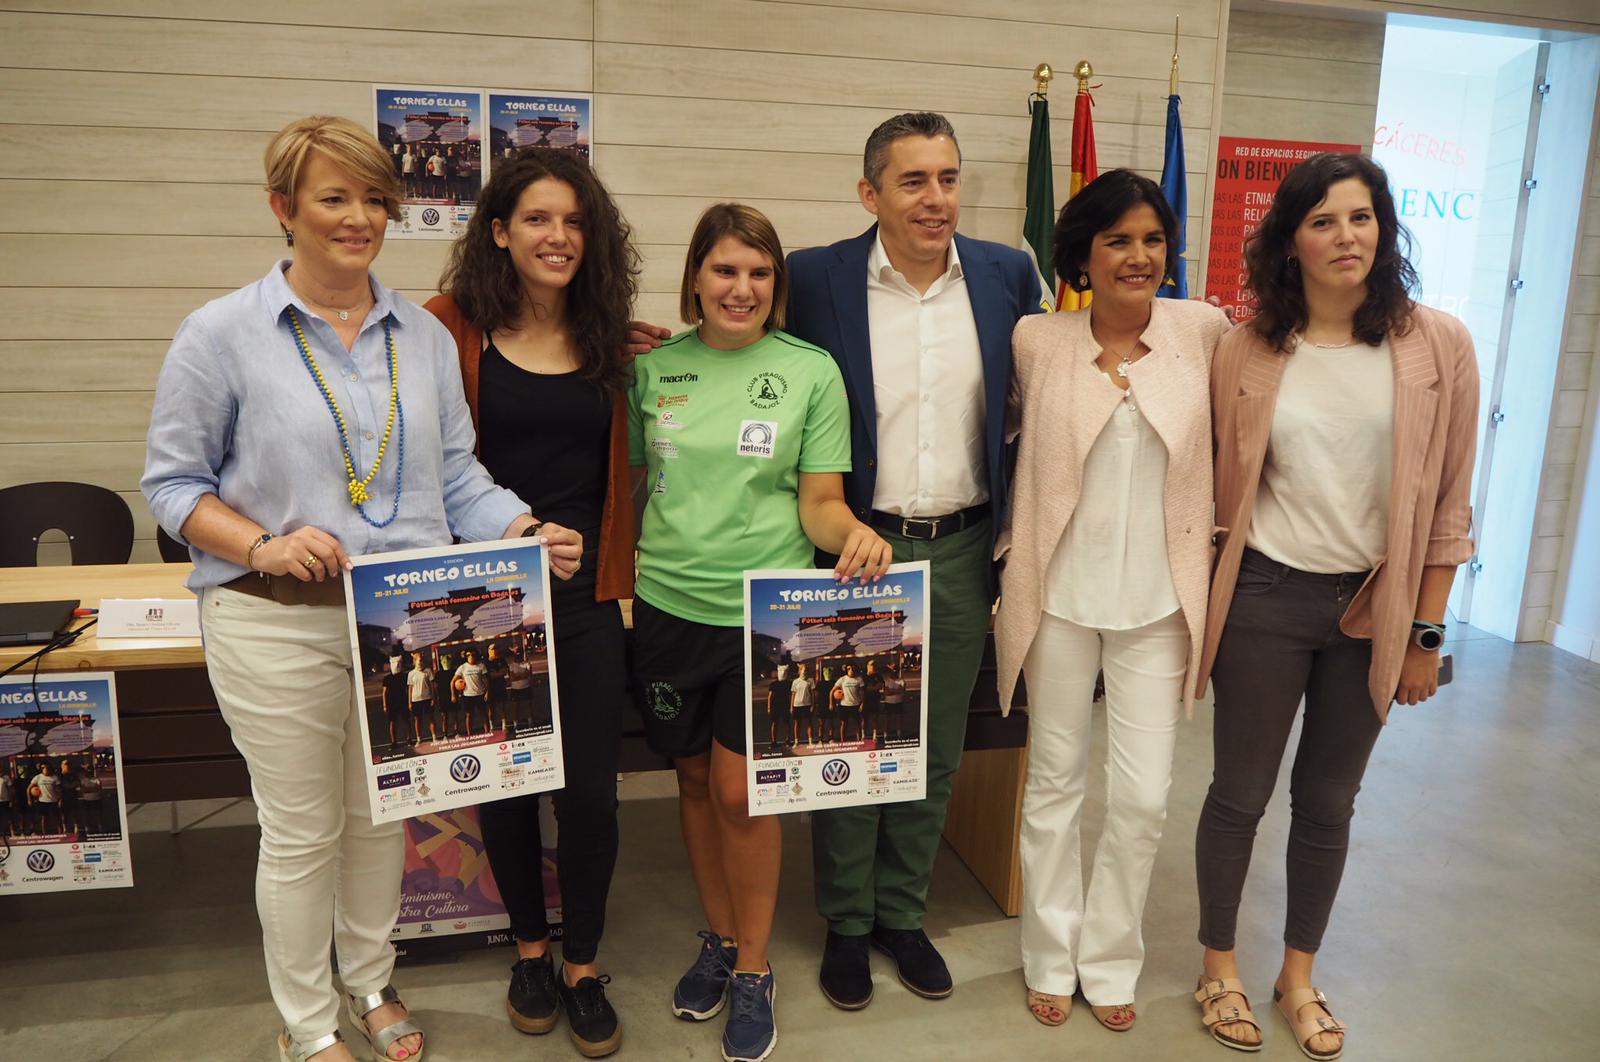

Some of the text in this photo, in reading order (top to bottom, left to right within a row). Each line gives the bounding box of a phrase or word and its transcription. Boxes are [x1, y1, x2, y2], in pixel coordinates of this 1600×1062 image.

[393, 97, 467, 107] TORNEO ELLAS
[506, 102, 577, 112] TORNEO ELLAS
[1373, 121, 1467, 168] CÁCERES
[1235, 147, 1249, 156] RED
[1250, 147, 1260, 157] DE
[1261, 148, 1294, 159] ESPACIOS
[659, 373, 698, 383] macron
[746, 377, 759, 393] CLUB
[750, 399, 780, 410] BADAJOZ
[740, 444, 771, 455] neteris
[384, 567, 460, 587] TORNEO
[463, 560, 518, 578] ELLAS
[779, 584, 903, 602] TORNEO ELLAS
[0, 690, 88, 704] NEO ELLAS
[383, 776, 405, 785] ALTAFIT
[445, 784, 490, 796] Centrowagen
[816, 788, 857, 797] Centrowagen
[22, 875, 63, 883] Centrowagen
[425, 901, 469, 918] Cultura
[488, 934, 509, 945] JUNTA
